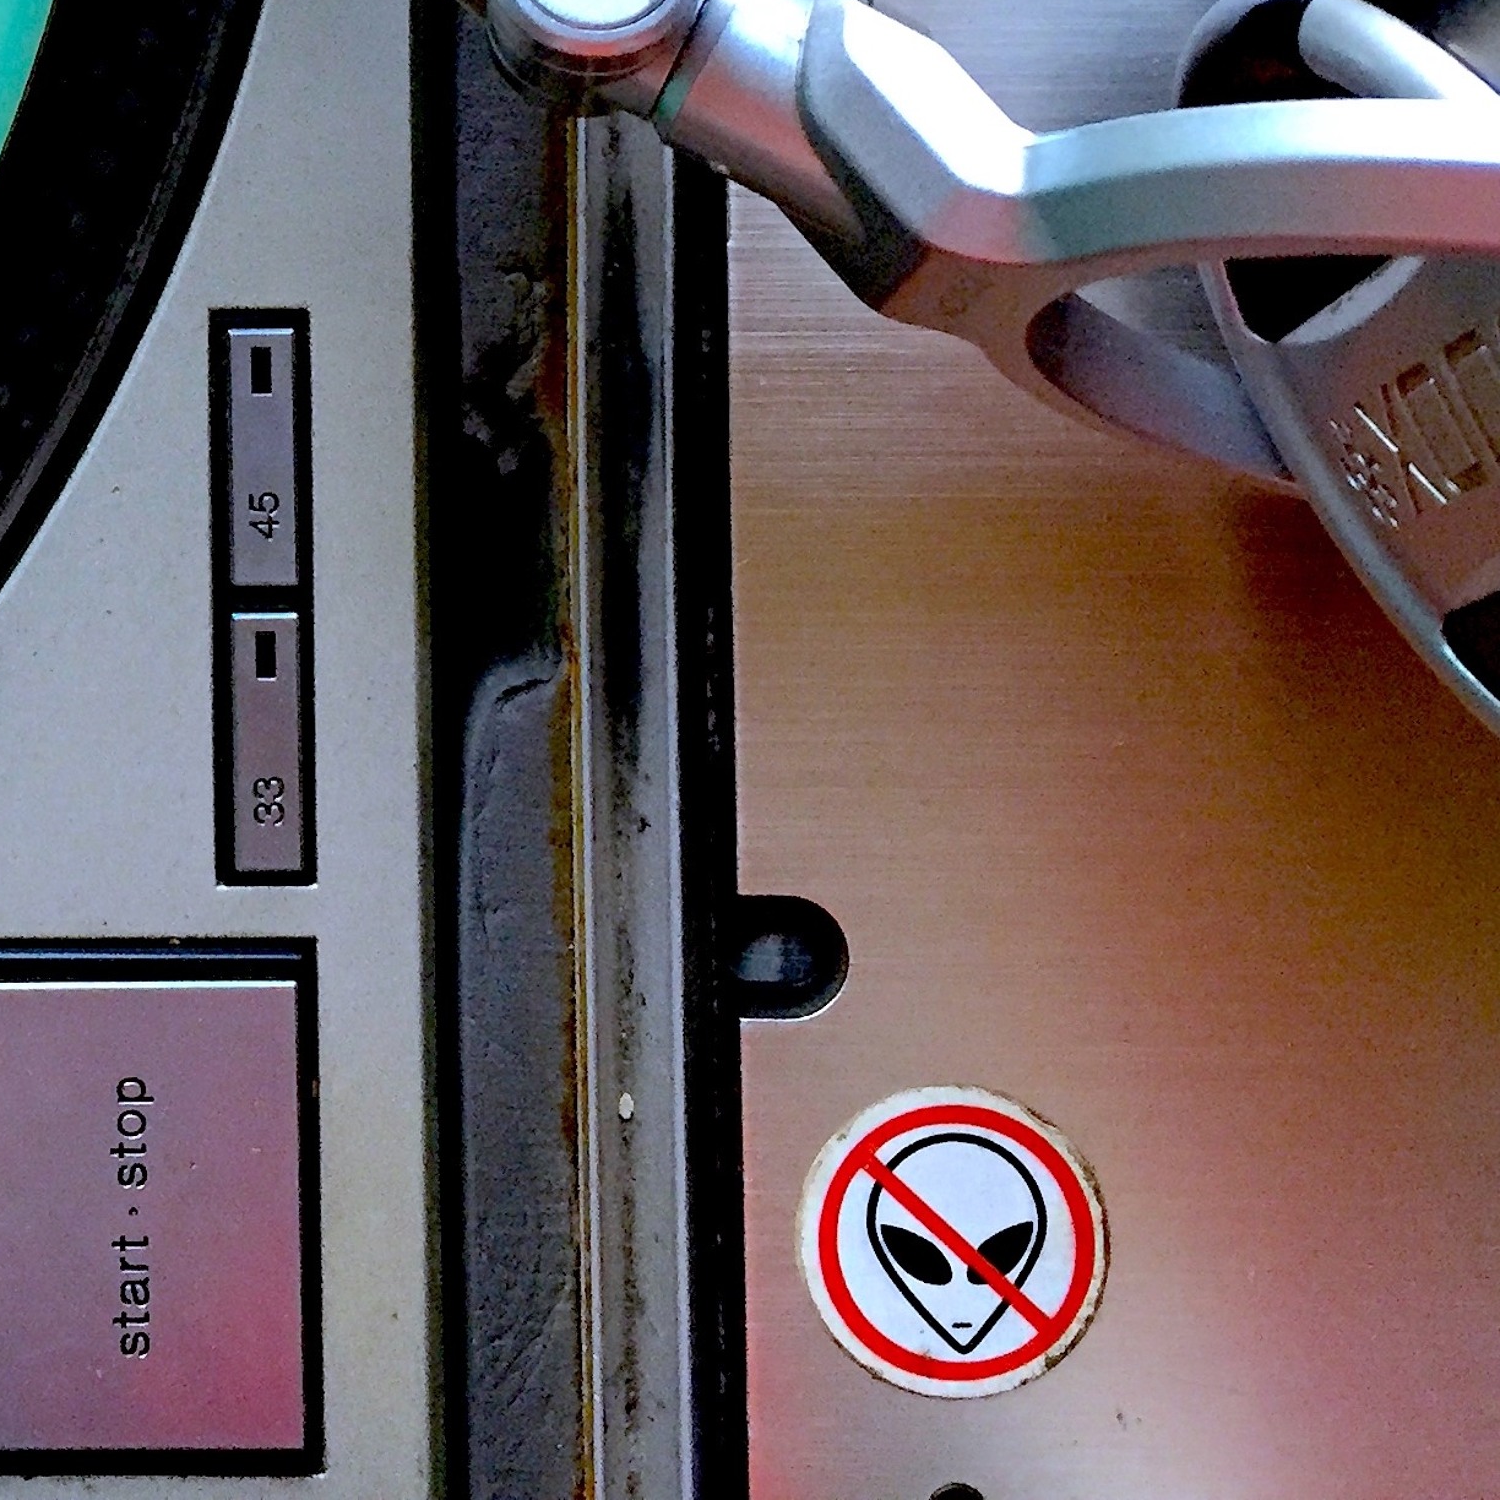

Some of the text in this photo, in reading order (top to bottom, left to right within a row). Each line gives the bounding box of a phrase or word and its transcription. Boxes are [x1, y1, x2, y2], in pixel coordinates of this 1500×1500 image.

[249, 491, 281, 540] 45
[253, 775, 286, 826] 33
[109, 1076, 155, 1360] start stop
